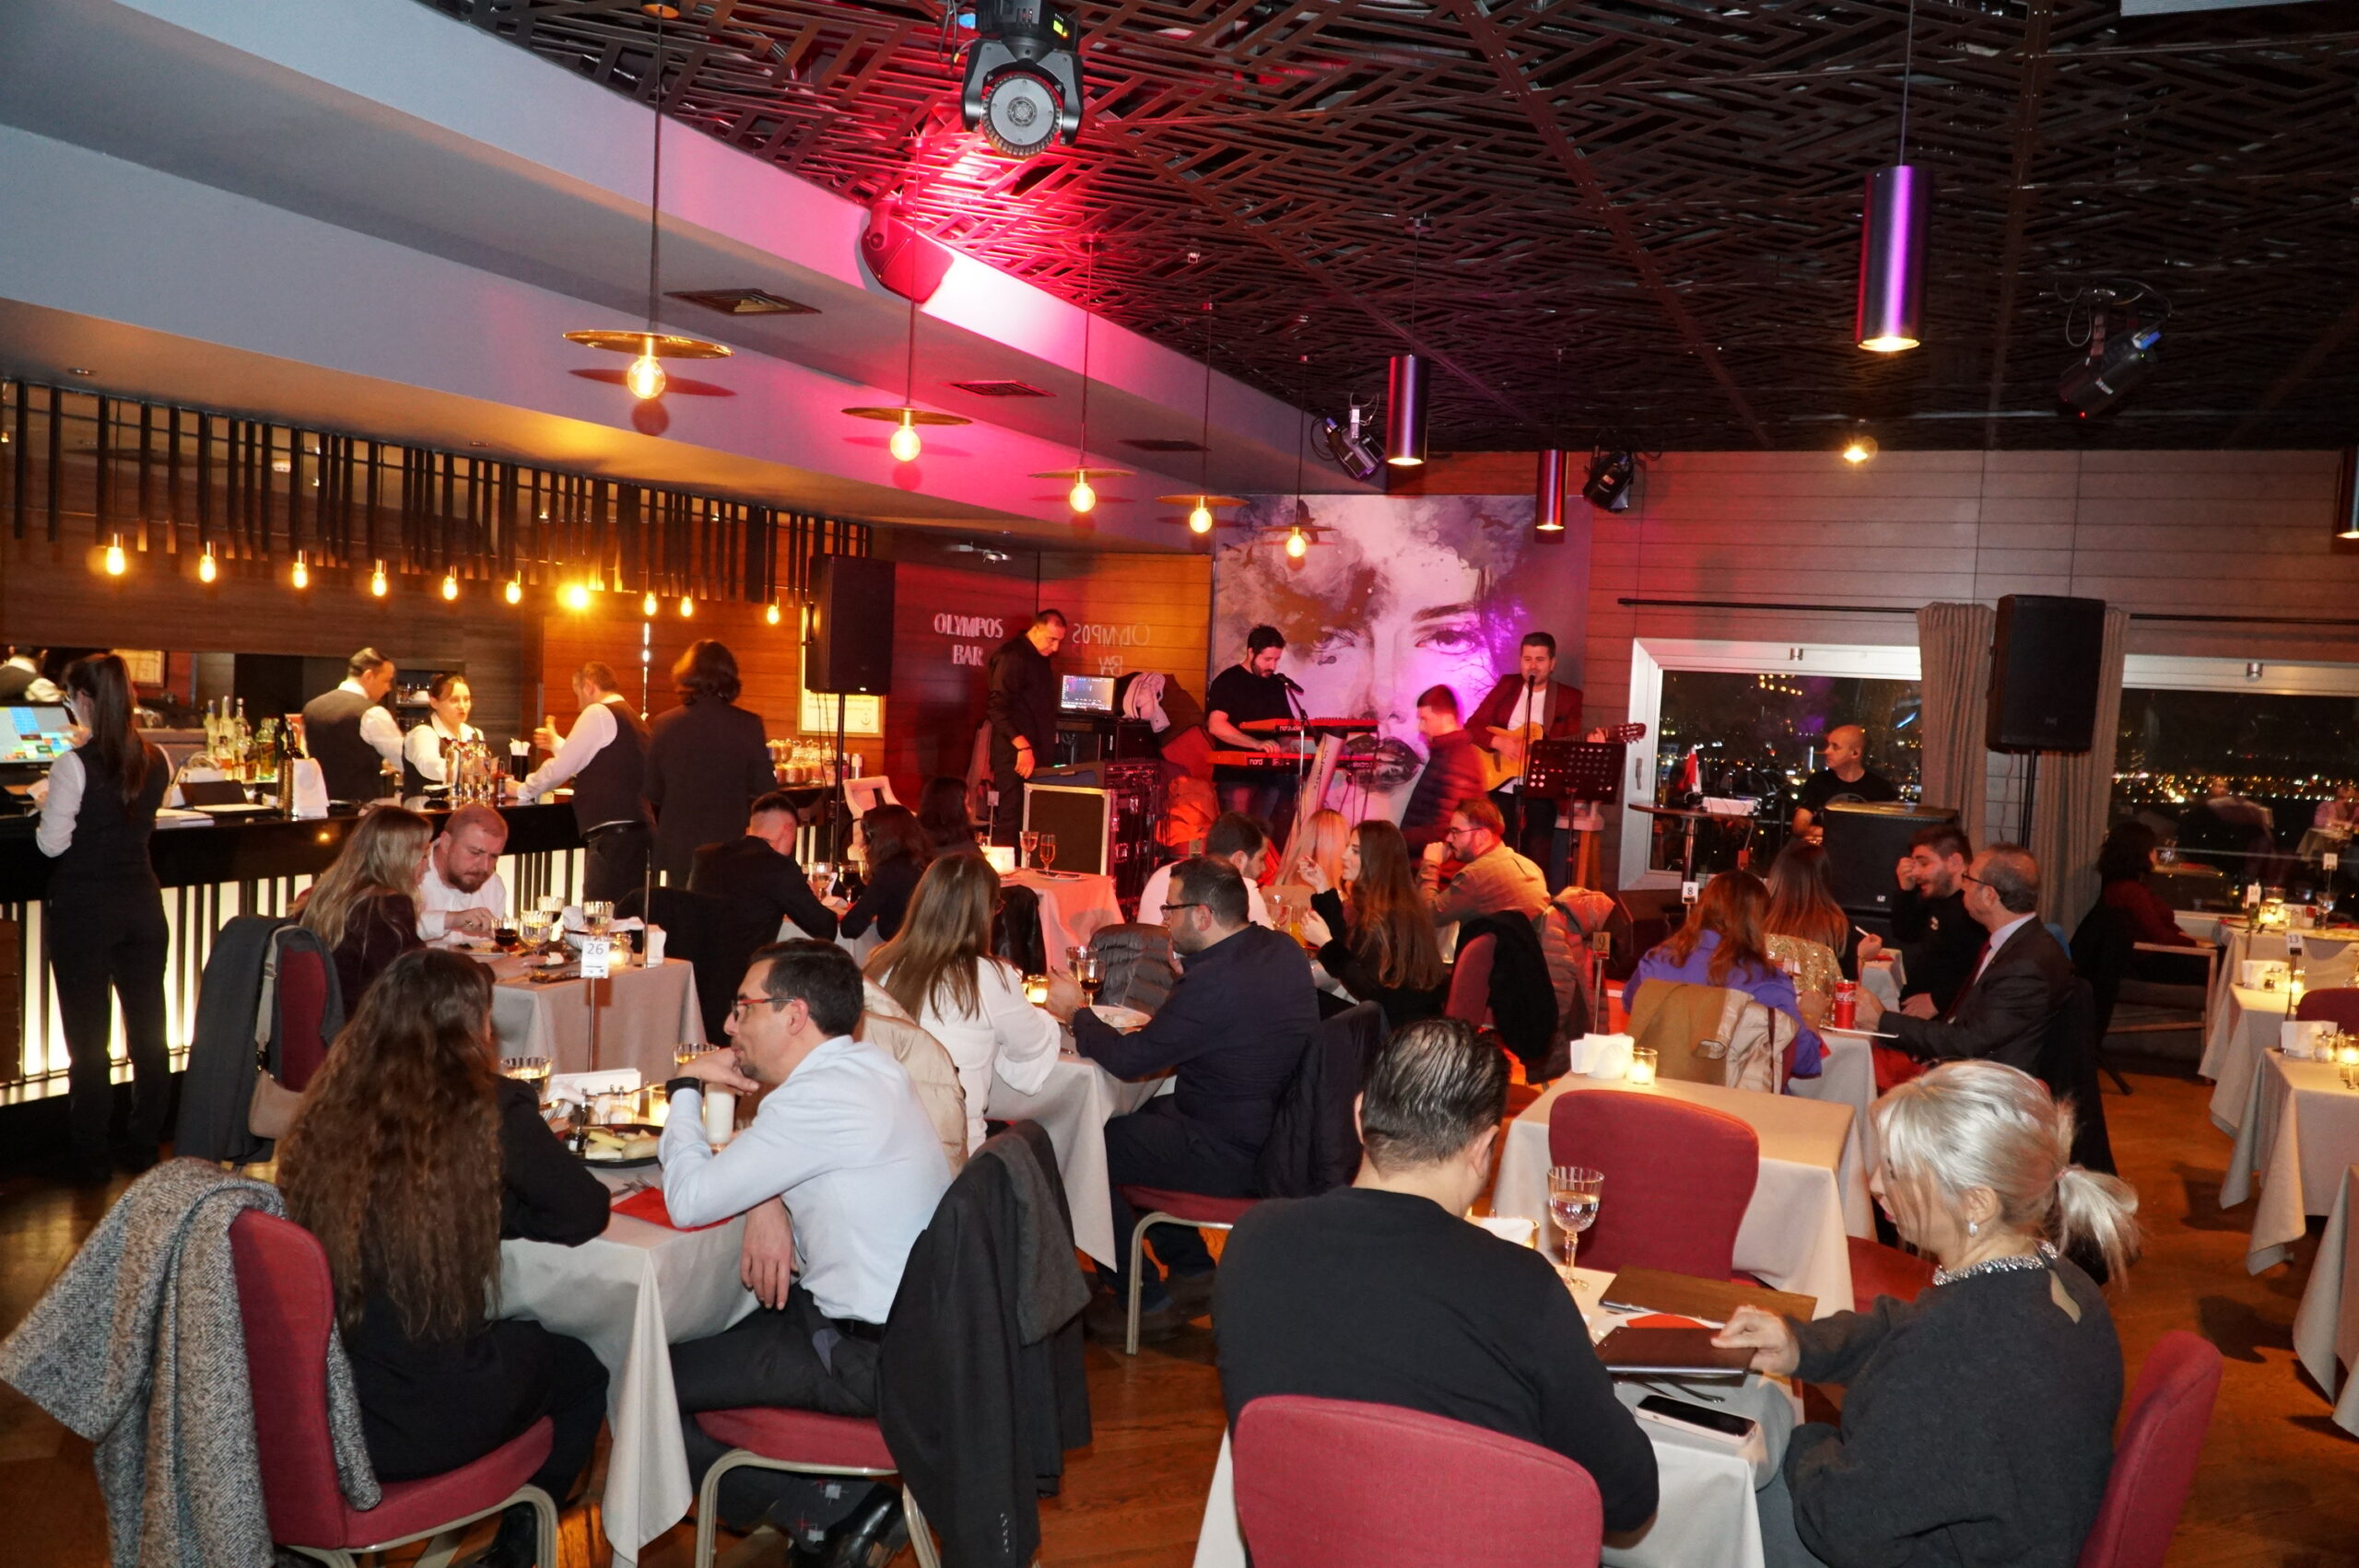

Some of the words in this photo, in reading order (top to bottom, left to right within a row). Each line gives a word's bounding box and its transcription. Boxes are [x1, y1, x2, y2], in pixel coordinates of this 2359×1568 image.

[934, 613, 1003, 638] OLYMPOS
[953, 644, 983, 667] BAR
[1688, 887, 1694, 895] 8
[1598, 935, 1606, 948] 9
[2289, 935, 2299, 943] 13
[587, 942, 604, 955] 26
